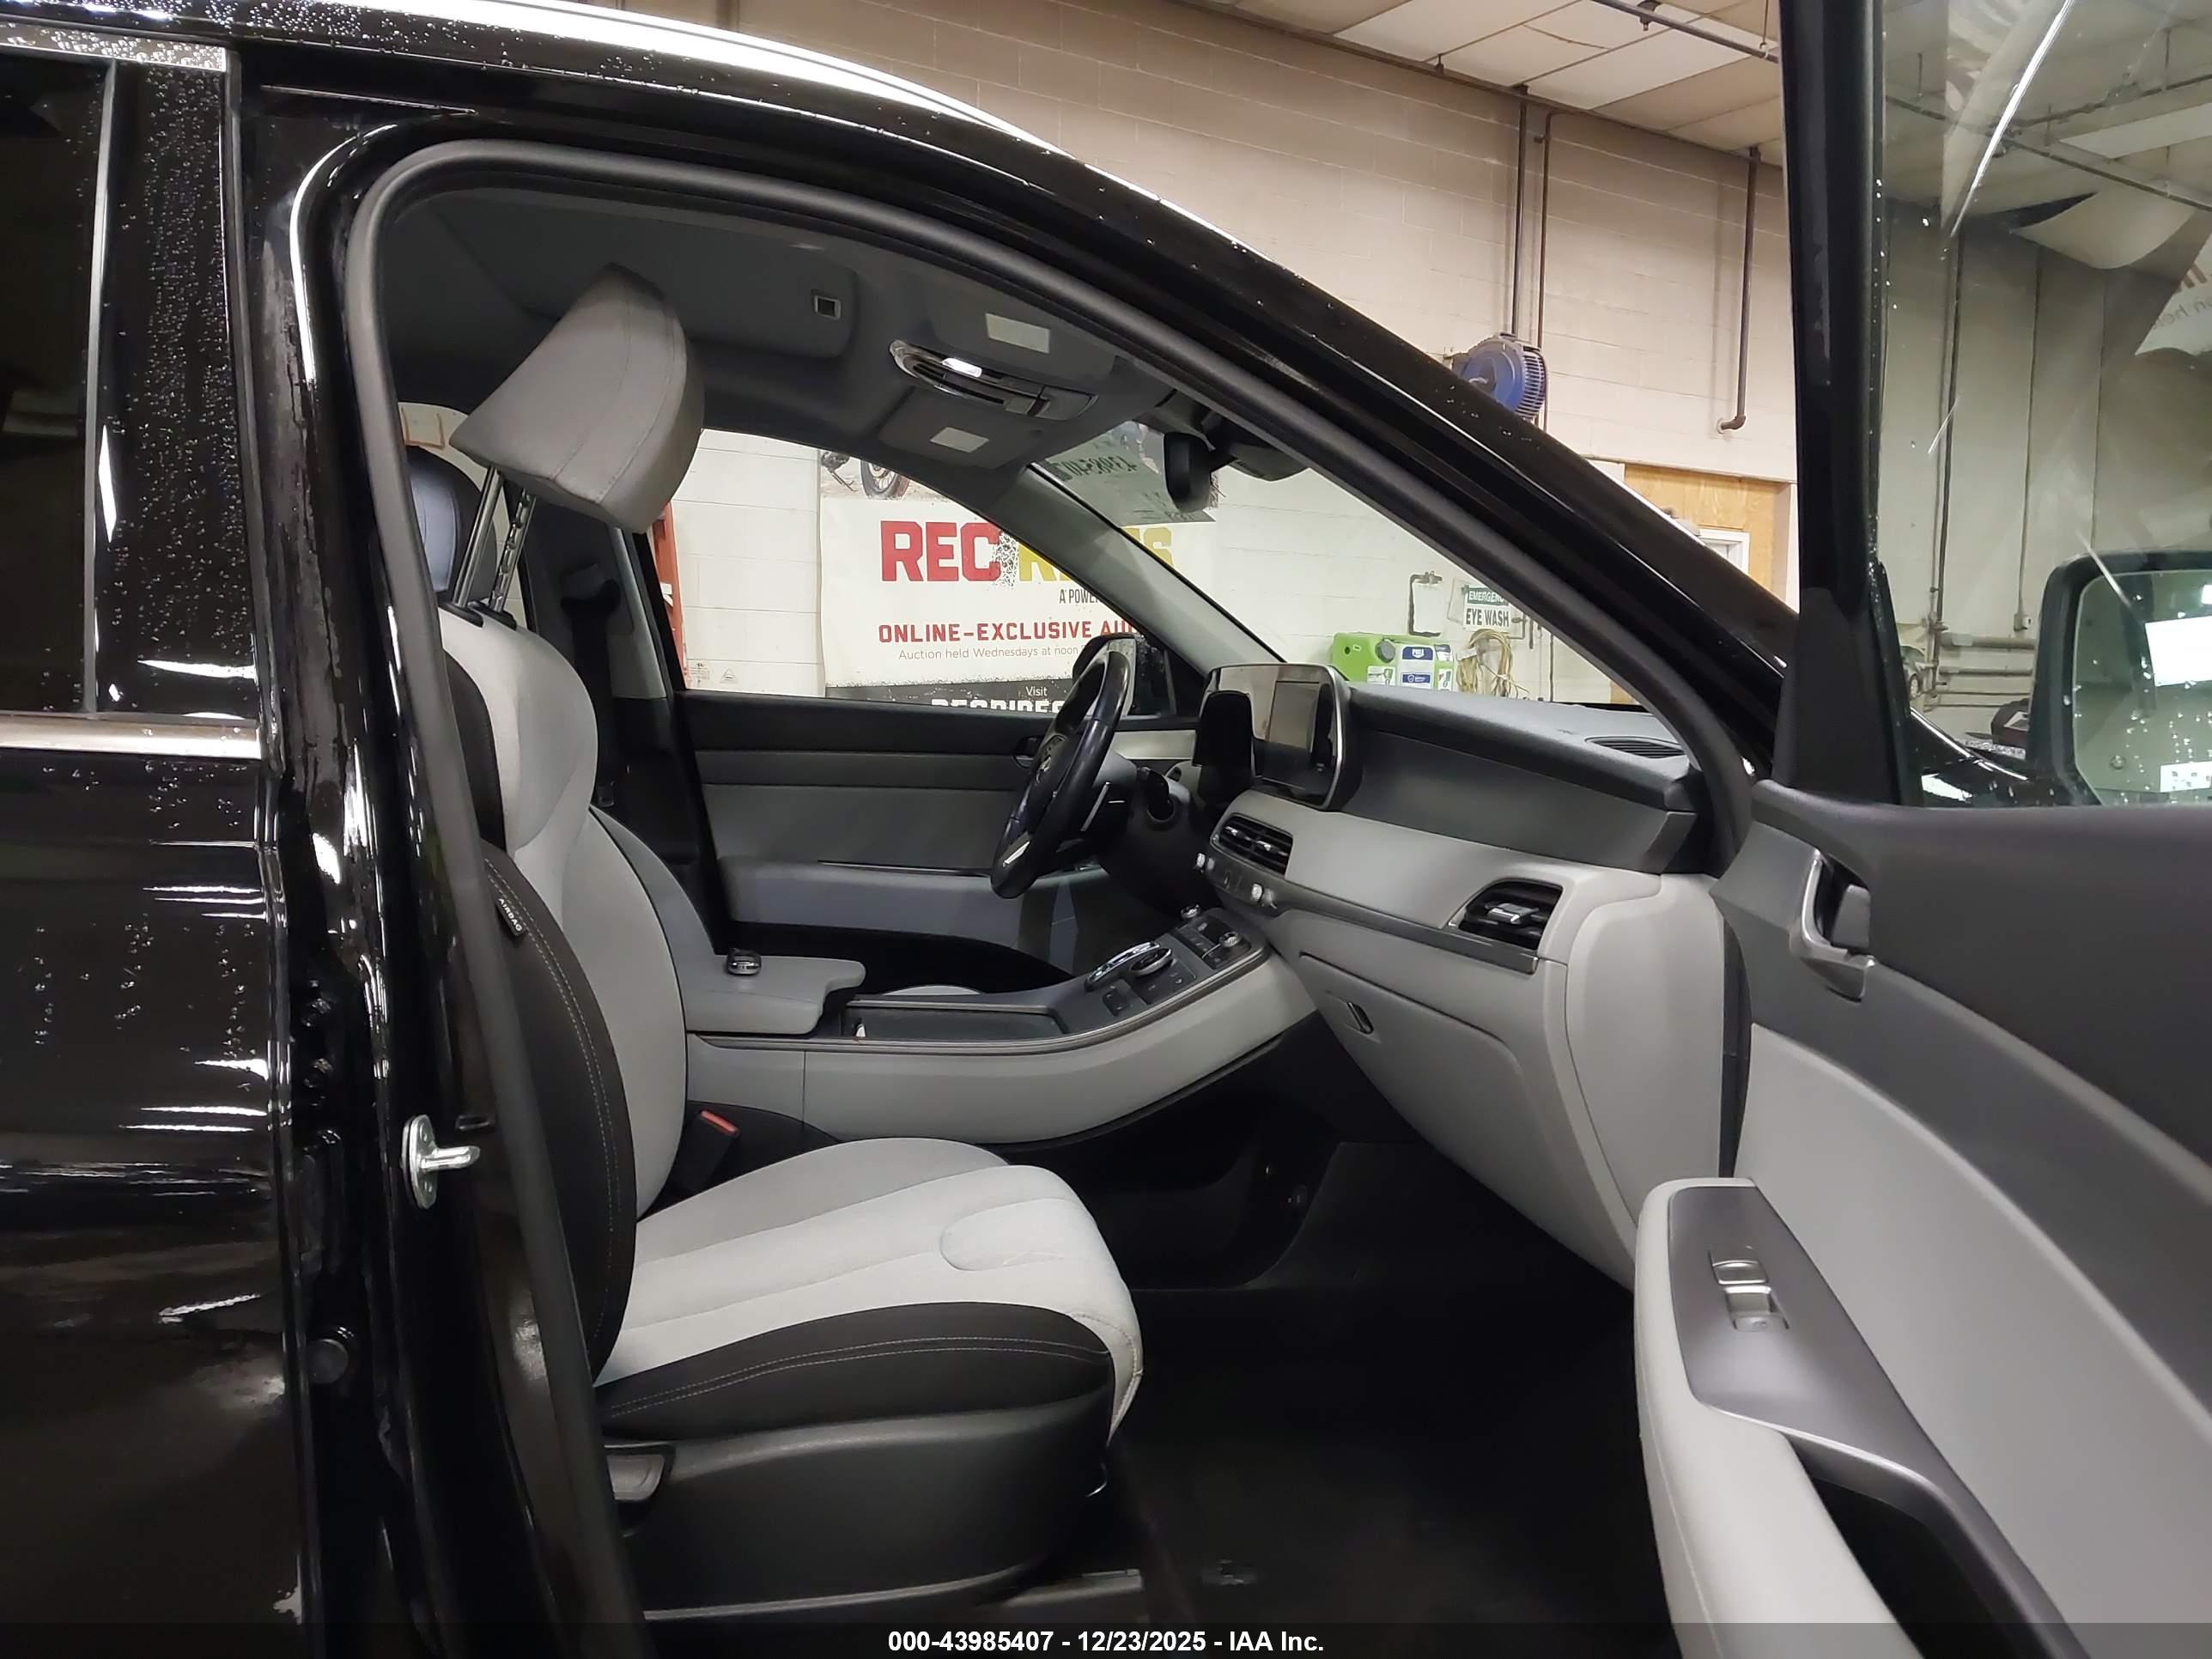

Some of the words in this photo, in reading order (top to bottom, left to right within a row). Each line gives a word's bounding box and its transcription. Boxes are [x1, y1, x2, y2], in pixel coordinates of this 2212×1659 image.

[880, 520, 1000, 582] REC
[1466, 608, 1482, 625] EYE
[1485, 610, 1509, 627] WASH
[878, 621, 1091, 643] ONLINE-EXCLUSIVE
[899, 649, 943, 660] Auction
[945, 647, 969, 659] held
[973, 645, 1038, 658] Wednesdays
[1042, 646, 1051, 656] at
[1054, 646, 1079, 656] noon
[1025, 686, 1048, 696] Visit
[498, 898, 523, 932] AIRBAG
